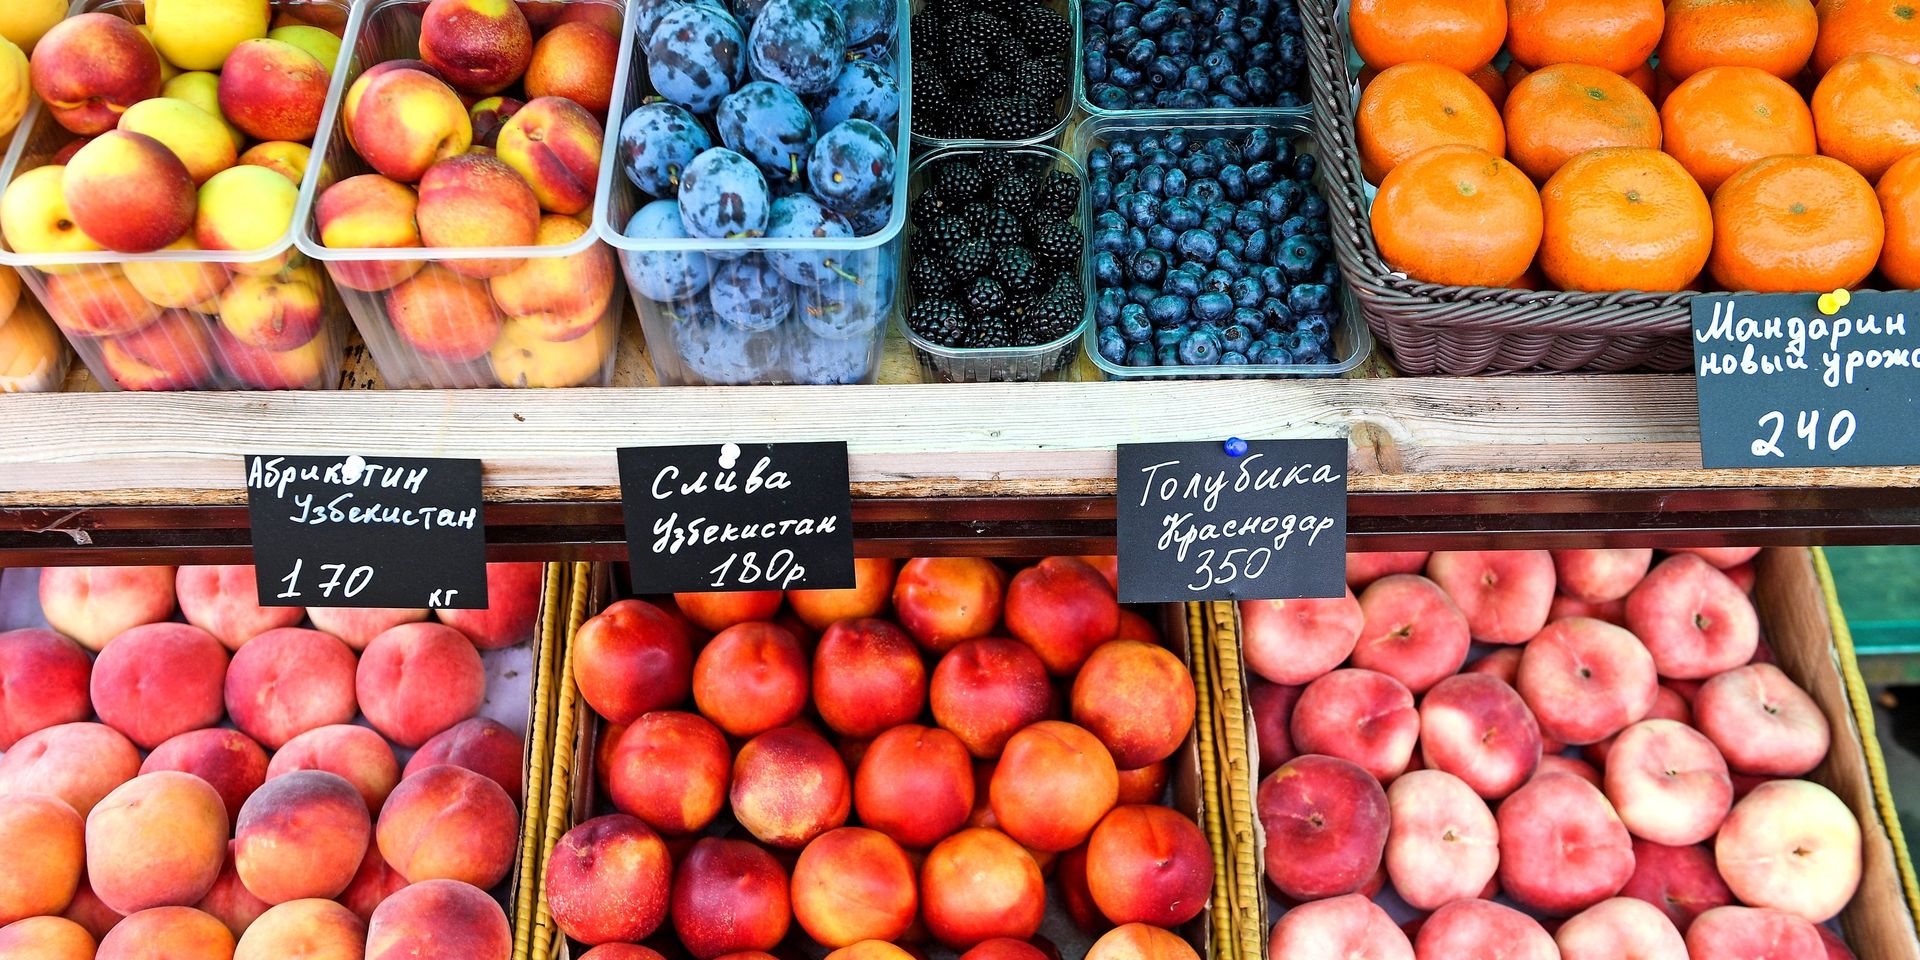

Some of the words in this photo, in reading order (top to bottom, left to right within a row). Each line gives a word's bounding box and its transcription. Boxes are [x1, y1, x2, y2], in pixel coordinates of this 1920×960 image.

[1696, 300, 1906, 357] Мандарин
[1700, 343, 1808, 377] новый
[1751, 409, 1857, 458] 240
[651, 456, 792, 500] Слива
[289, 493, 477, 530] Узбекистан
[652, 512, 837, 554] Узбекистан
[1157, 512, 1335, 562] Краснодар
[1187, 547, 1272, 591] 350
[428, 588, 458, 607] кг
